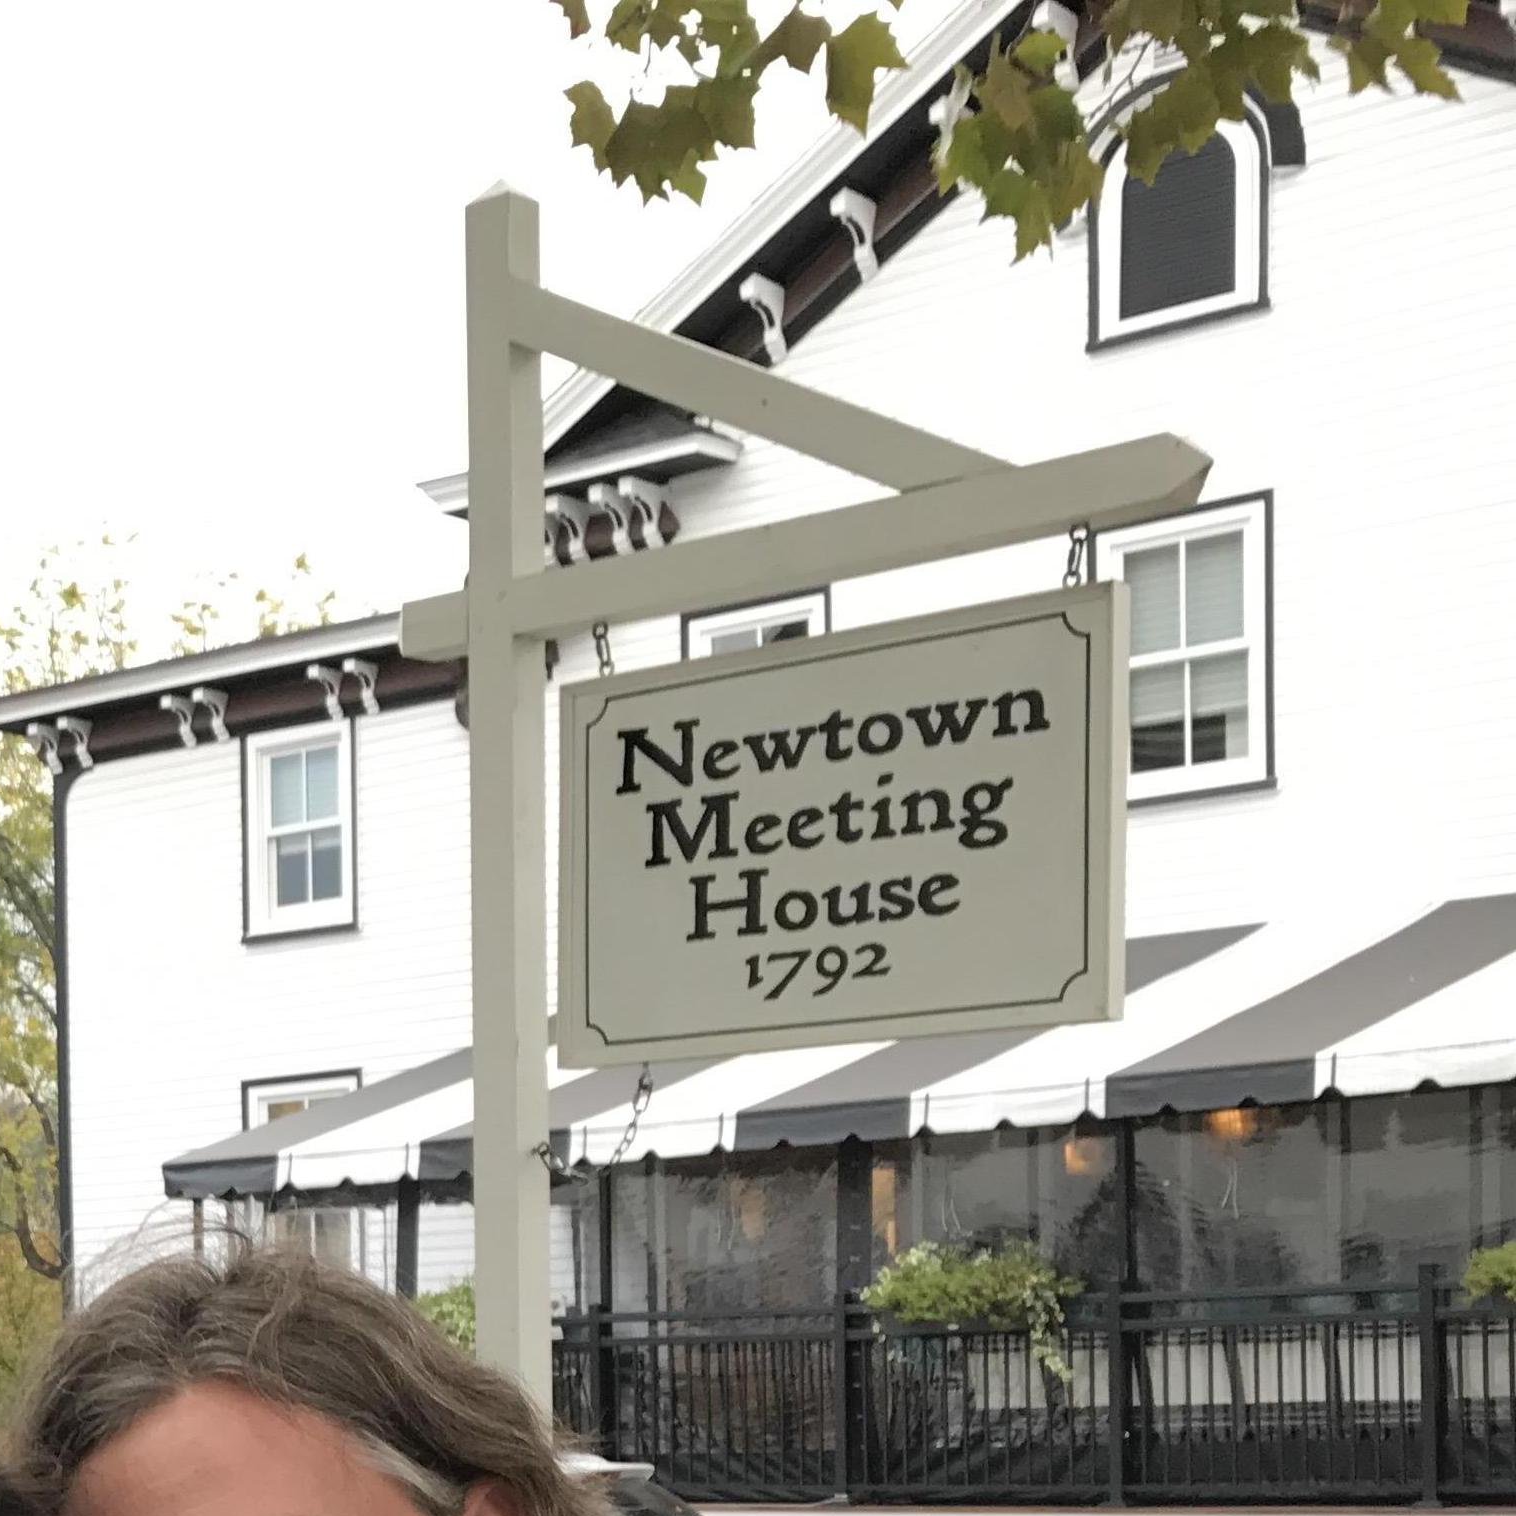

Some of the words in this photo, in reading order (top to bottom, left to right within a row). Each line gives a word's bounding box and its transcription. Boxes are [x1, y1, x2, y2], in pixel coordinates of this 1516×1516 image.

[615, 688, 1051, 797] Newtown
[644, 773, 1014, 870] Meeting
[685, 867, 961, 943] House
[745, 942, 891, 1001] 1792
